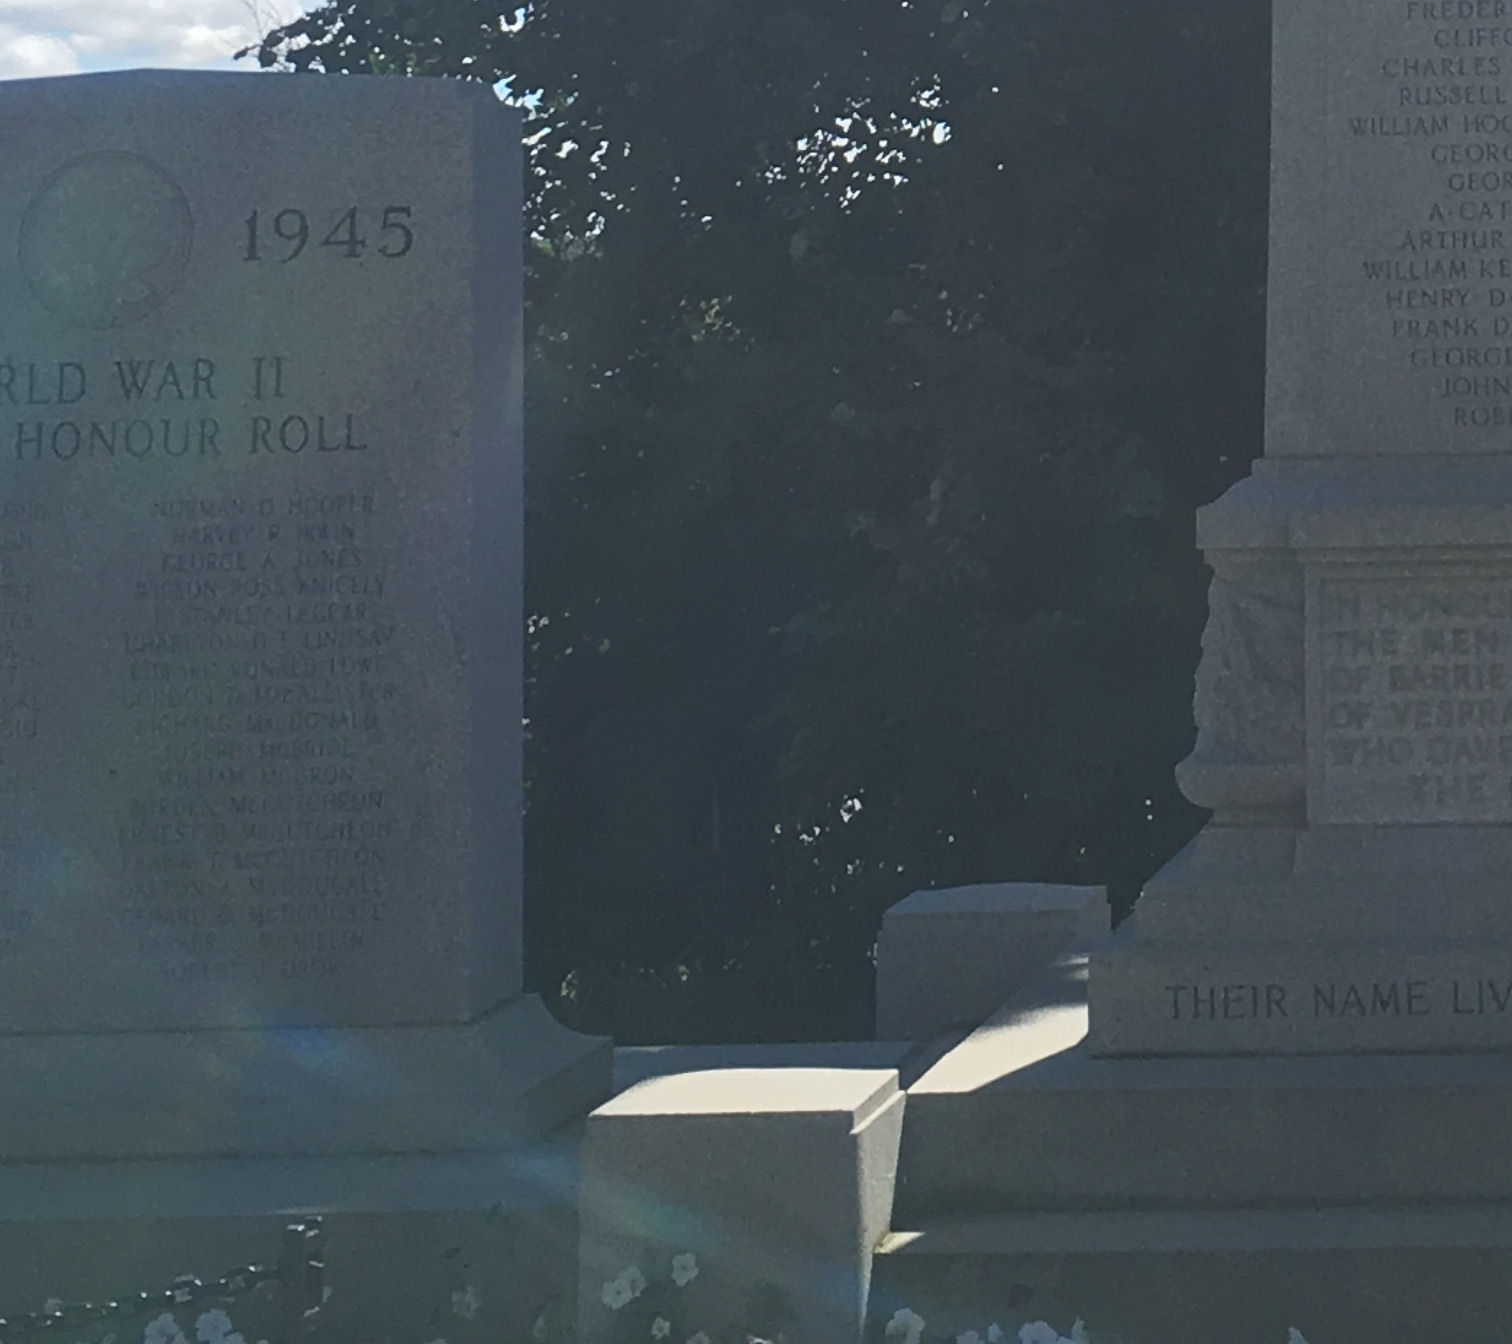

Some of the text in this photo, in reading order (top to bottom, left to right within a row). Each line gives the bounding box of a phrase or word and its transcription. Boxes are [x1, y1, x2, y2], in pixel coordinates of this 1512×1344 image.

[1382, 57, 1501, 78] CHARLES
[1399, 85, 1507, 106] RUSSELL
[1349, 114, 1448, 137] WILLIAM
[242, 205, 414, 264] 1945
[1400, 230, 1503, 251] ARTHUR
[1362, 259, 1467, 280] WILLIAM
[1386, 288, 1470, 309] HENRY
[1392, 318, 1478, 338] FRANK
[113, 358, 217, 402] WAR
[253, 356, 286, 400] II
[1441, 376, 1510, 398] JOHN
[15, 414, 368, 460] HONOUR ROLL
[1330, 630, 1398, 656] THE
[1422, 627, 1500, 656] MEN
[1326, 666, 1371, 693] OF
[1388, 663, 1507, 692] BARRIE
[1329, 702, 1372, 730] OF
[1328, 739, 1414, 765] WHO
[1410, 774, 1488, 804] THE
[1163, 984, 1288, 1021] THEIR
[1313, 981, 1428, 1018] NAME
